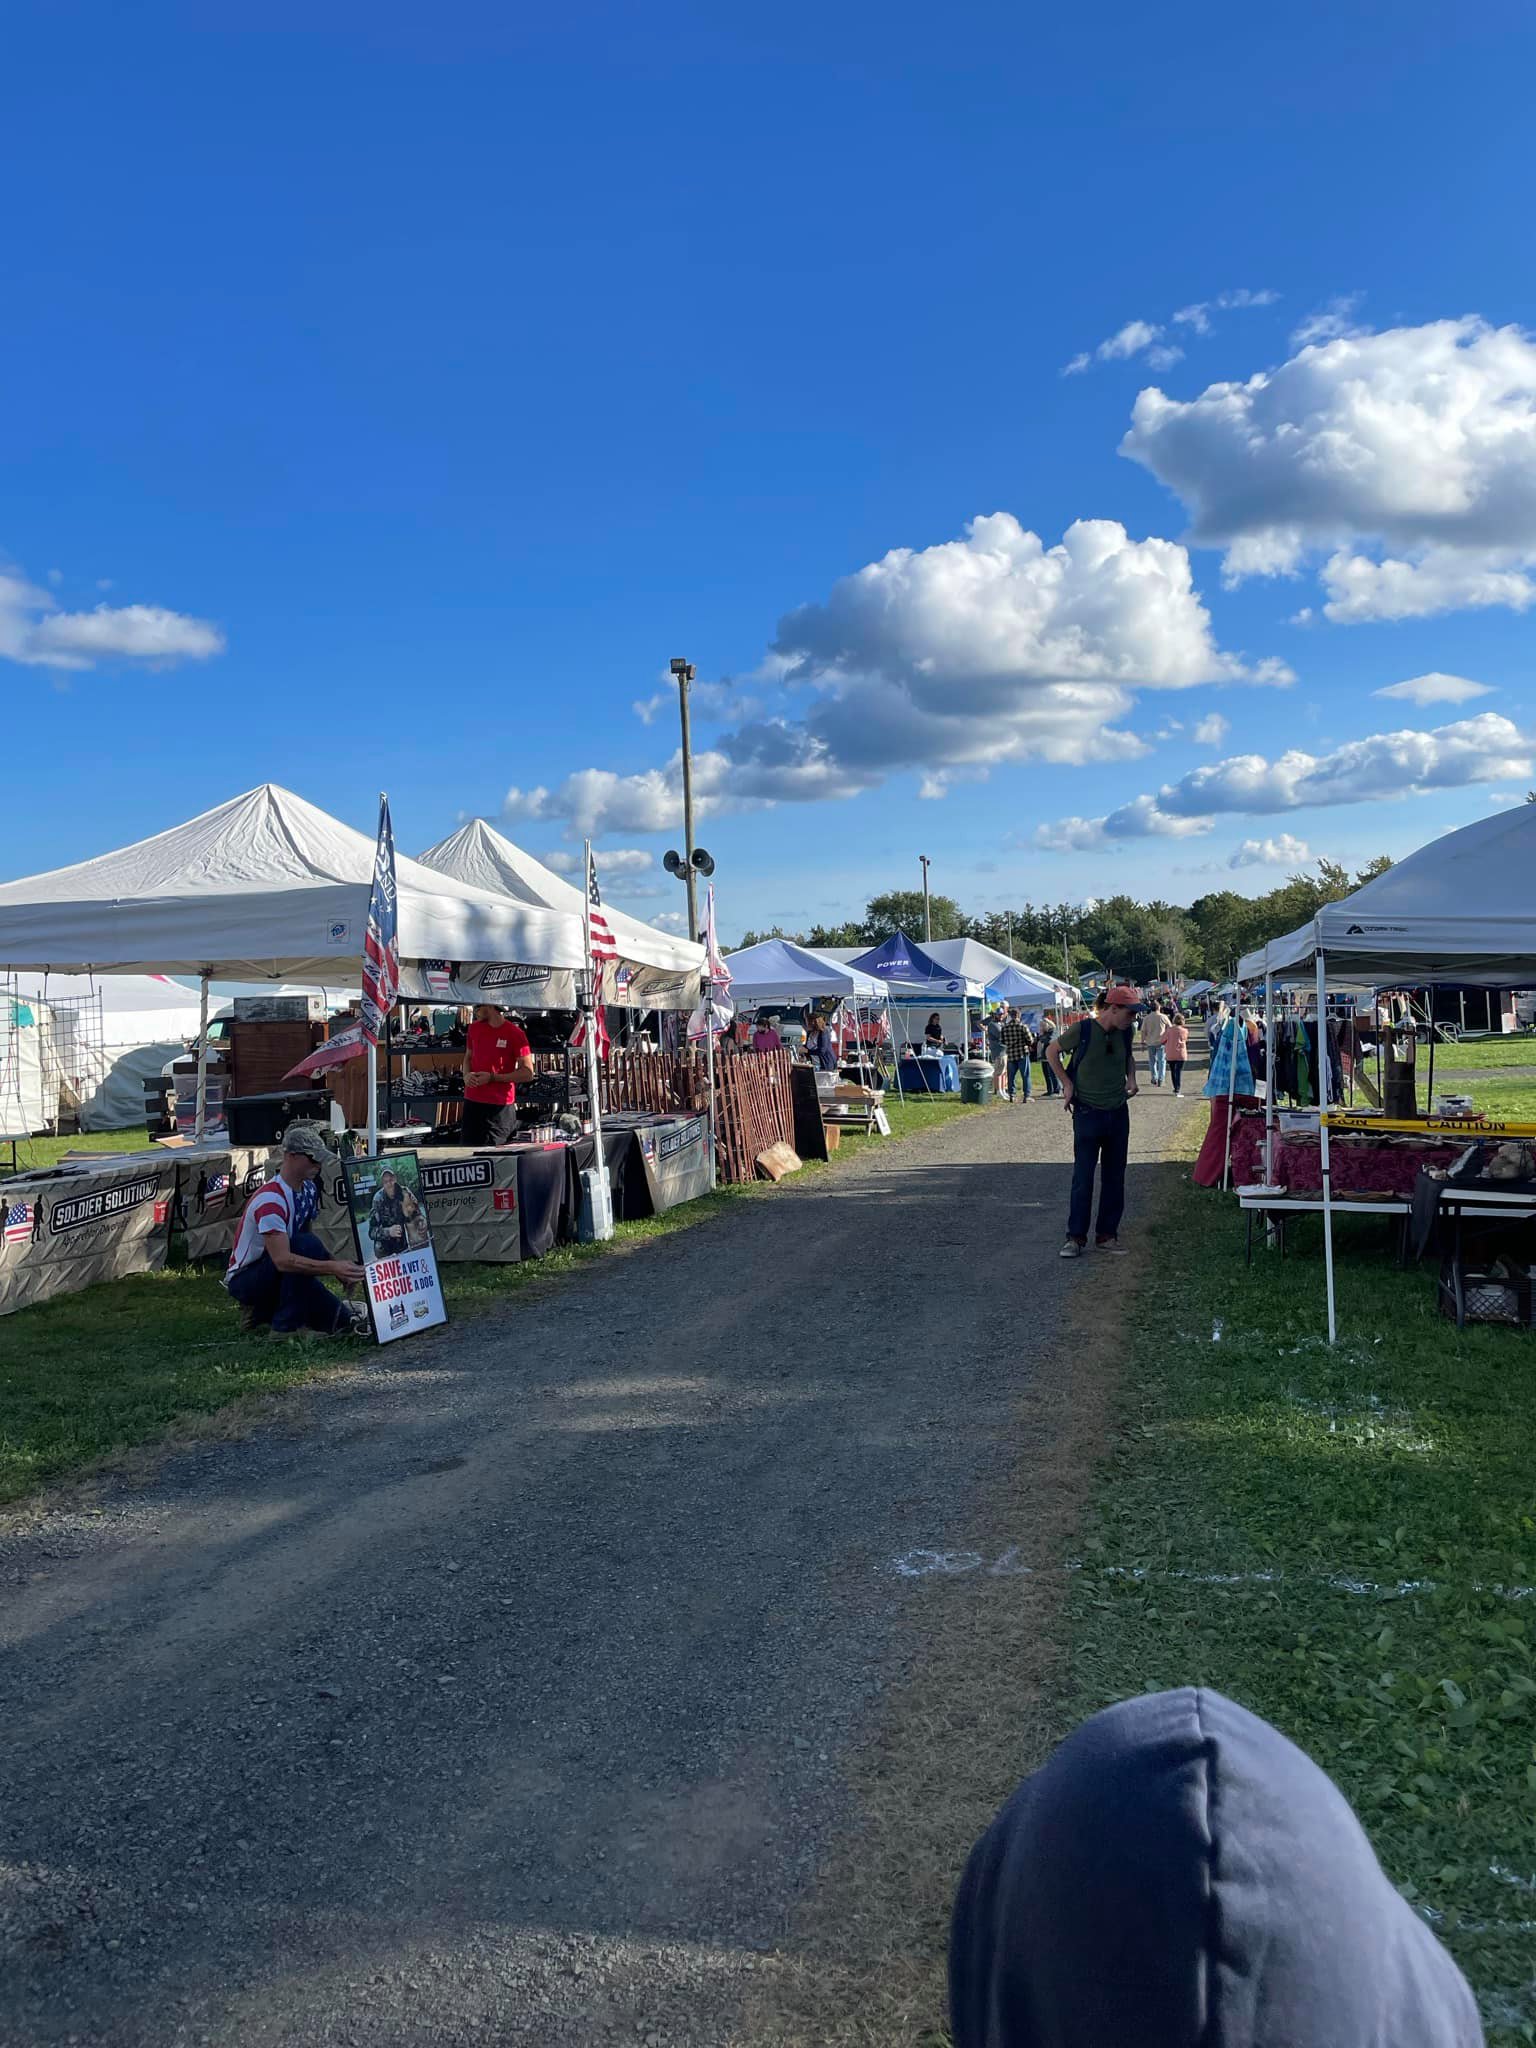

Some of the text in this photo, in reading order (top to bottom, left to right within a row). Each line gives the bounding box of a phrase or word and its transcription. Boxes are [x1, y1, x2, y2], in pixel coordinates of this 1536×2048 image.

[876, 960, 909, 969] POWER
[483, 967, 517, 984] SOLDIER
[1426, 1121, 1505, 1131] CAUTION
[55, 1196, 103, 1227] SOLDIER
[375, 1260, 402, 1282] SAVE
[402, 1264, 408, 1276] A
[407, 1260, 420, 1275] VET
[373, 1275, 434, 1303] RESCUE A DOG
